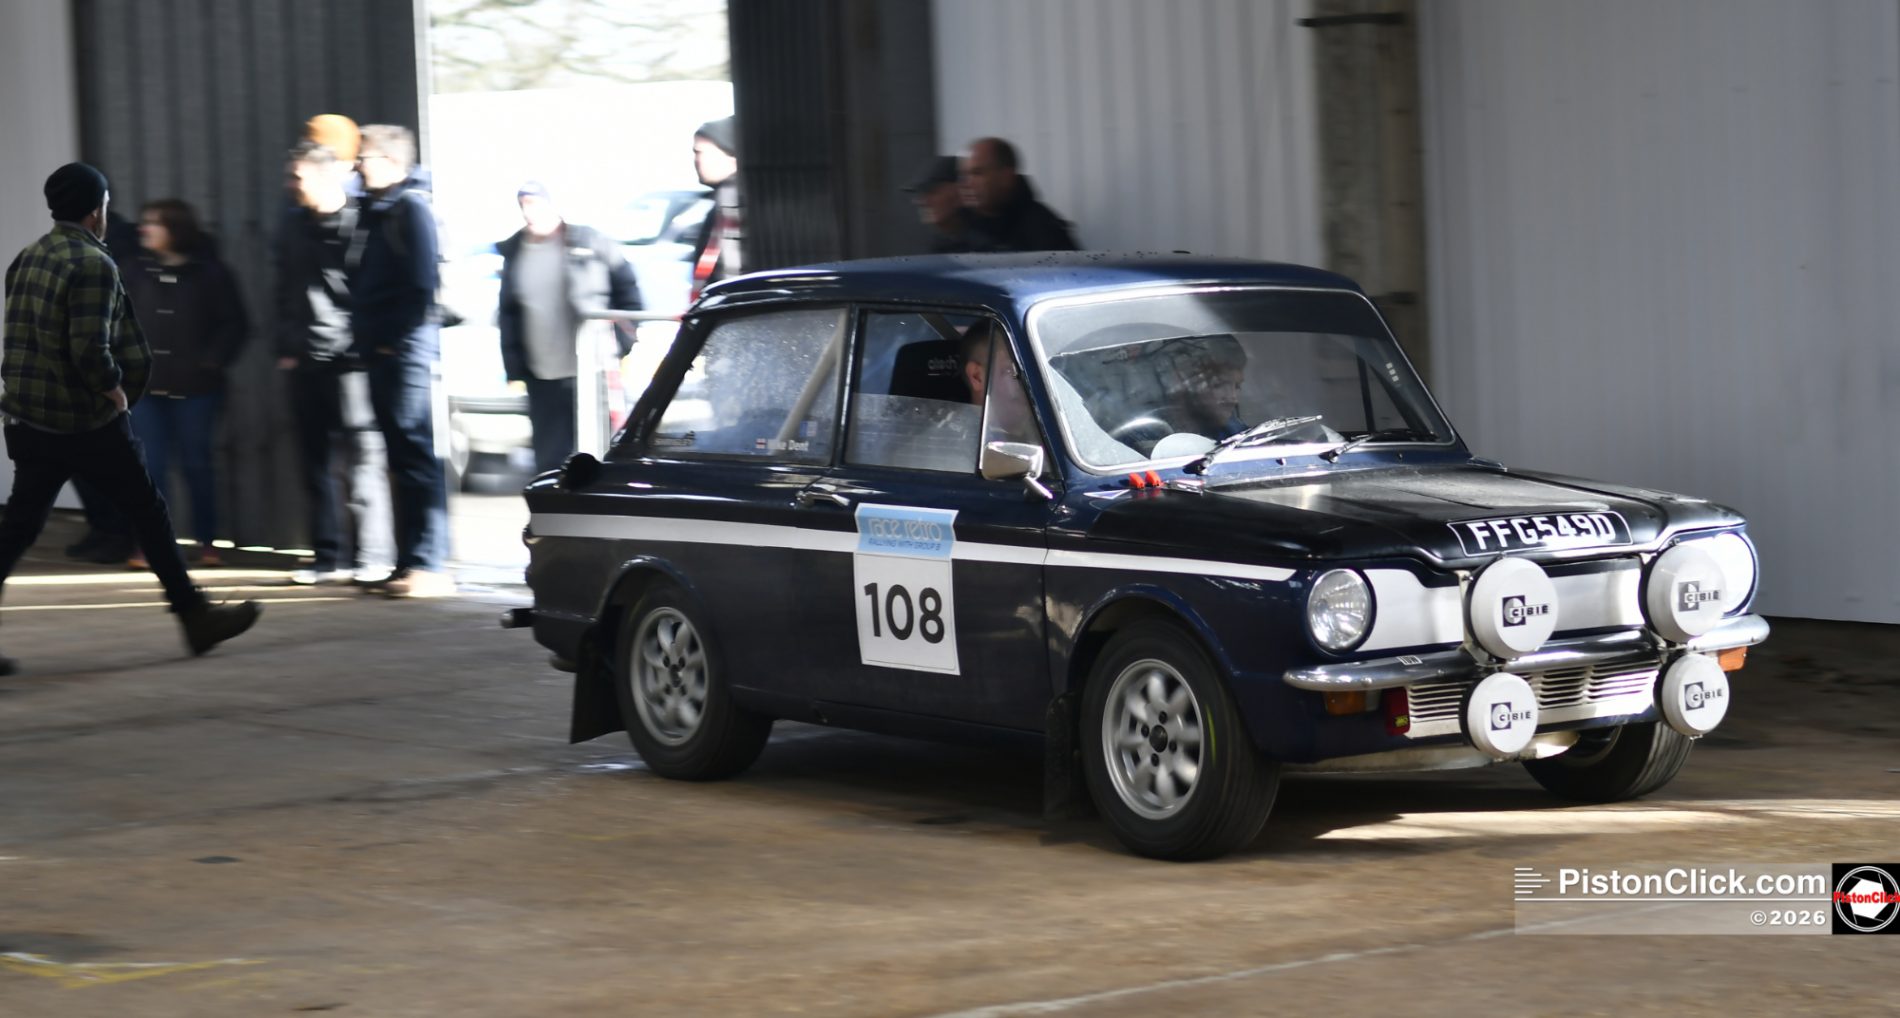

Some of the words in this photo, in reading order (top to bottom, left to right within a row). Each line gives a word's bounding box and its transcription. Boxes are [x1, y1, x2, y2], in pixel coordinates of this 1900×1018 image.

[869, 519, 902, 538] race
[904, 518, 942, 541] retro
[1466, 514, 1616, 550] FFG549D
[864, 582, 945, 644] 108
